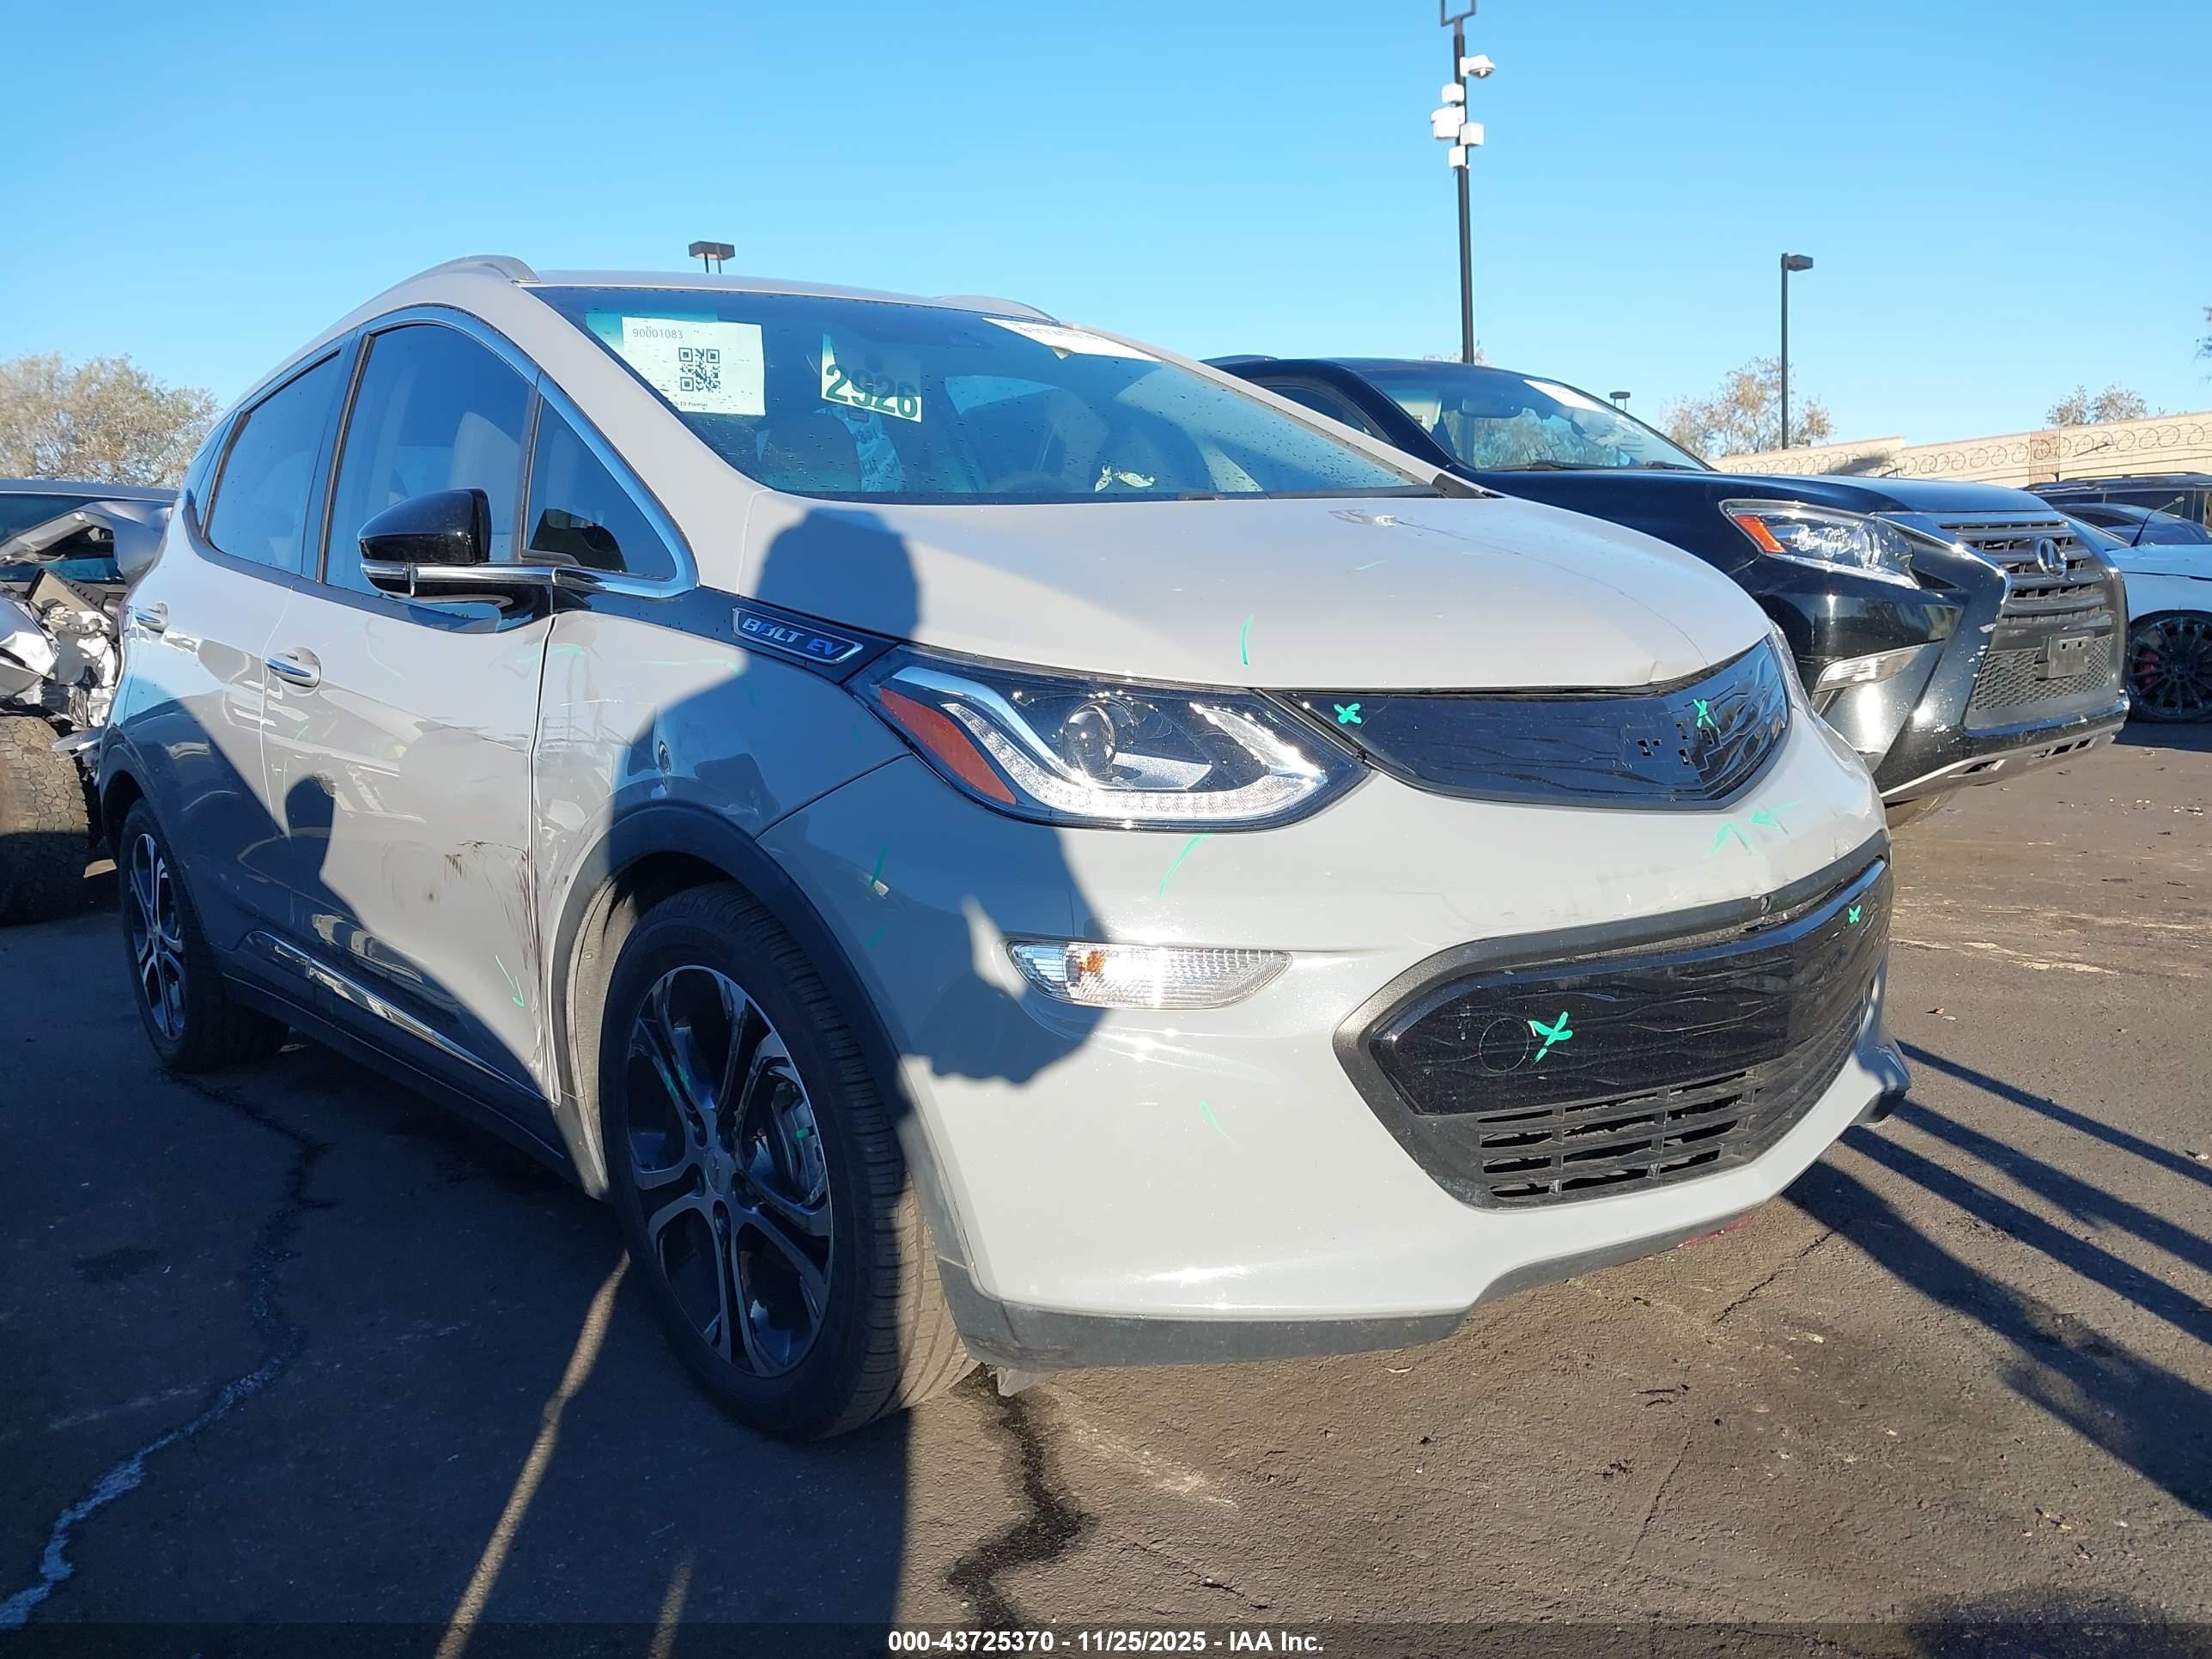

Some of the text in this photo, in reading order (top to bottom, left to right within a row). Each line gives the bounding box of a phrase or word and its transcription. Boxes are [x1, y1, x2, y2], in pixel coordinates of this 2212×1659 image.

[632, 328, 684, 339] 90001083
[826, 364, 918, 418] 2926
[742, 617, 845, 655] BOLT EV
